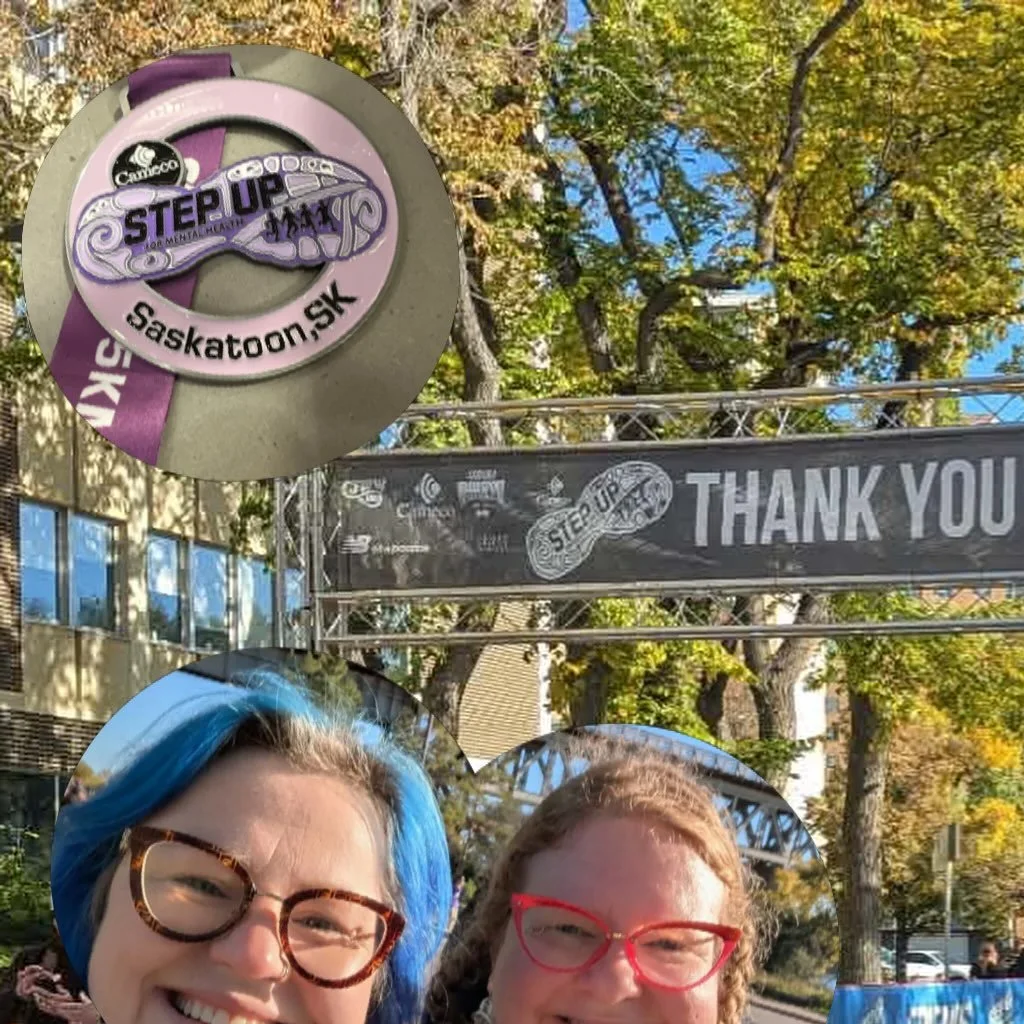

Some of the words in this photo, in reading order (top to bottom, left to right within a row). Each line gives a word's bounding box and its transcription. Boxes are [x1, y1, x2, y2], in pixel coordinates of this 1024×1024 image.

[114, 159, 178, 186] Cameco
[124, 188, 221, 246] STEP
[231, 173, 286, 215] UP
[164, 233, 201, 247] MENTAL
[206, 219, 244, 235] HEALTH
[548, 503, 591, 553] STEP
[594, 481, 620, 513] UP
[686, 464, 883, 547] THANK
[901, 456, 1016, 539] YOU
